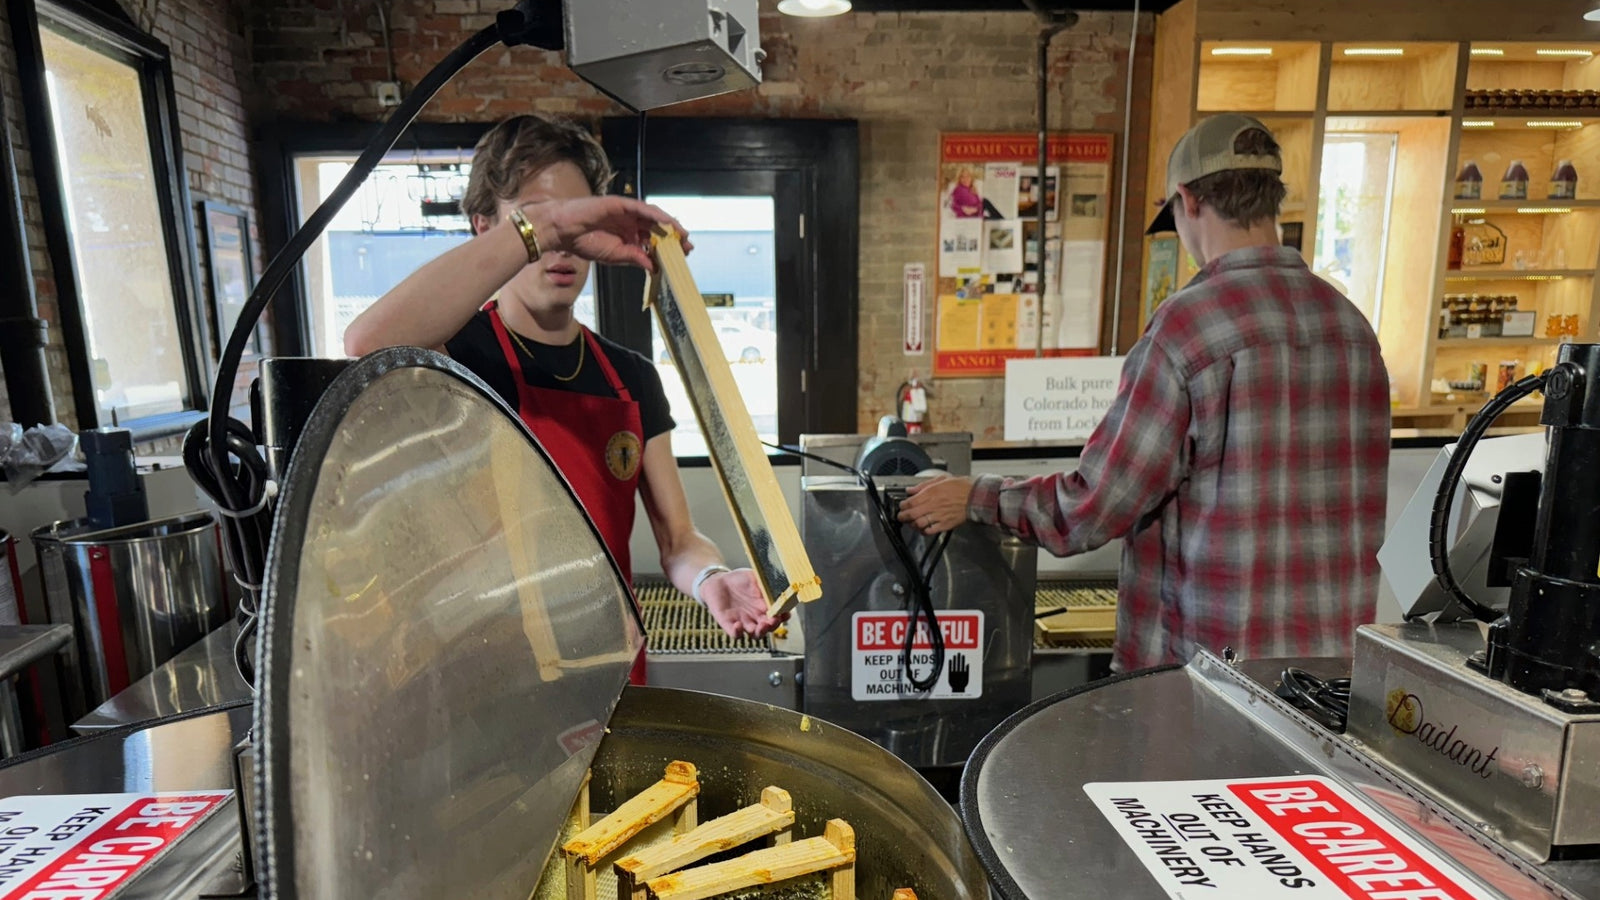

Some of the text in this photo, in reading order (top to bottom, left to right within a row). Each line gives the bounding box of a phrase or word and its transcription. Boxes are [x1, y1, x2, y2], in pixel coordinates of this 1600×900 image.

[945, 143, 1108, 156] COMMUNIT BOARD
[945, 354, 1006, 368] ANNOU
[1045, 376, 1113, 394] Bulk pure
[1023, 396, 1088, 412] Colorado
[1028, 416, 1062, 431] from
[862, 621, 887, 646] BE
[865, 655, 893, 666] KEEP
[880, 669, 902, 679] OUT
[1388, 693, 1499, 779] Dadant
[1248, 786, 1341, 817] BE
[45, 807, 112, 841] KEEP
[115, 801, 210, 831] BE
[1109, 797, 1218, 889] MACHINERY
[1170, 812, 1247, 867] OUT OF
[1191, 793, 1316, 889] KEEP HANDS
